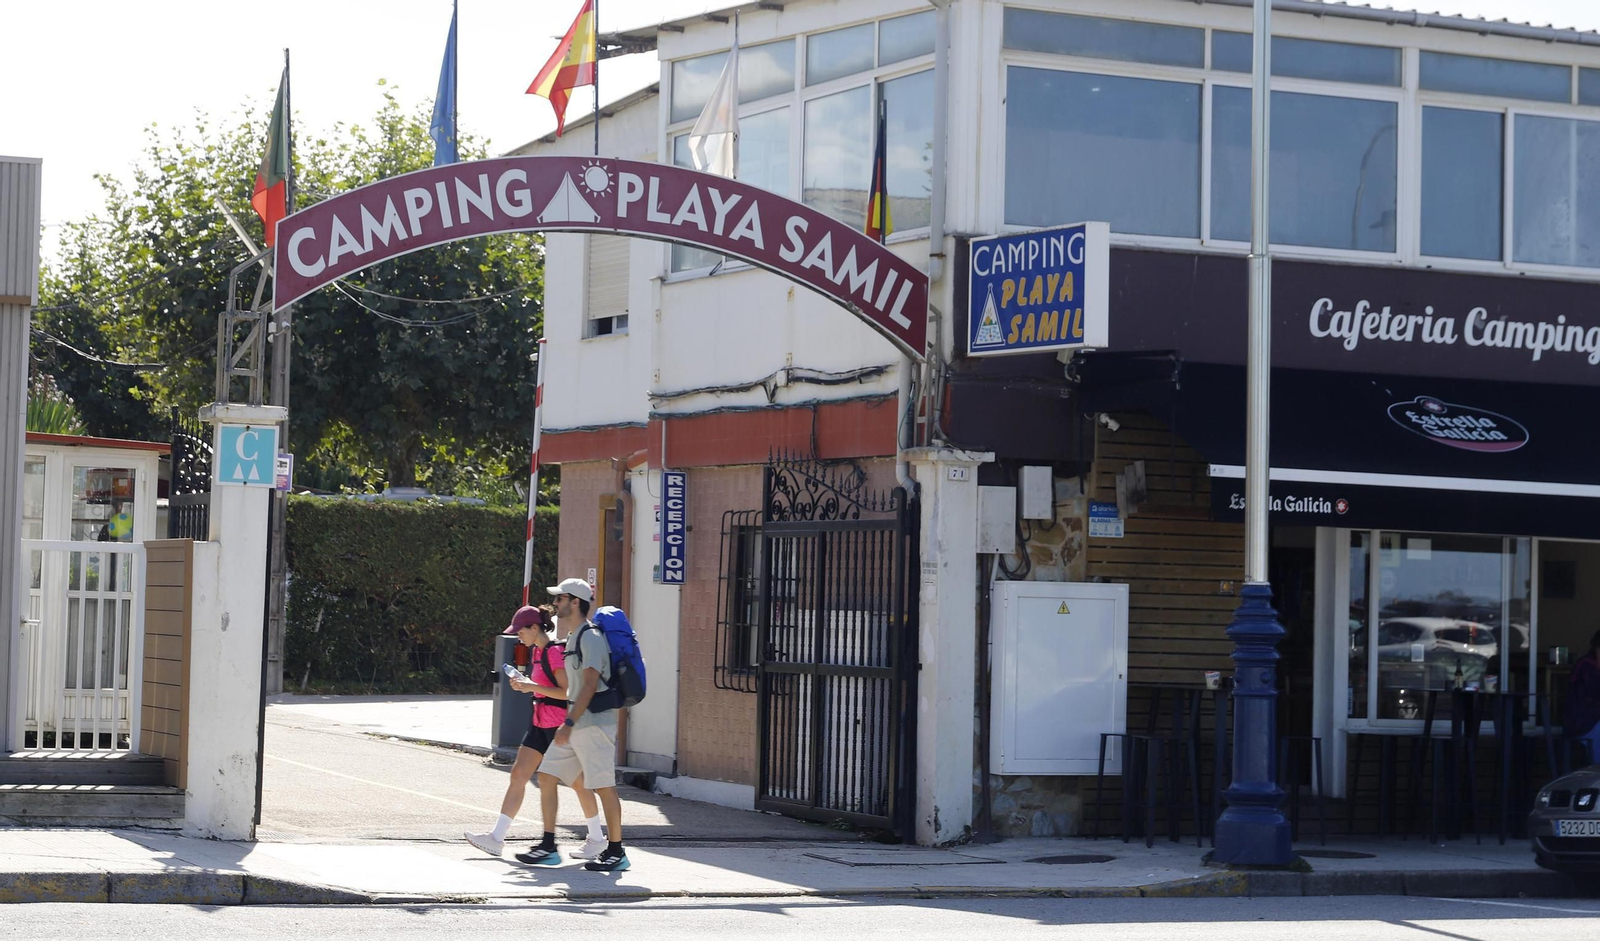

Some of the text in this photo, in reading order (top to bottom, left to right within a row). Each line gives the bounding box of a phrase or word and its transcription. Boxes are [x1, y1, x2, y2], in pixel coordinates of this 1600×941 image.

[287, 168, 914, 331] CAMPING PLAYA SAMIL
[973, 232, 1085, 277] CAMPING
[1001, 271, 1074, 309] PLAYA
[1007, 308, 1083, 345] SAMIL
[1309, 297, 1600, 365] Cafeteria Camping
[1405, 410, 1498, 428] Estrella
[1421, 424, 1508, 440] Galicia
[236, 430, 259, 461] C
[1229, 493, 1332, 513] Esla Galicia
[665, 475, 684, 581] RECEPCION
[1561, 821, 1586, 835] 5232
